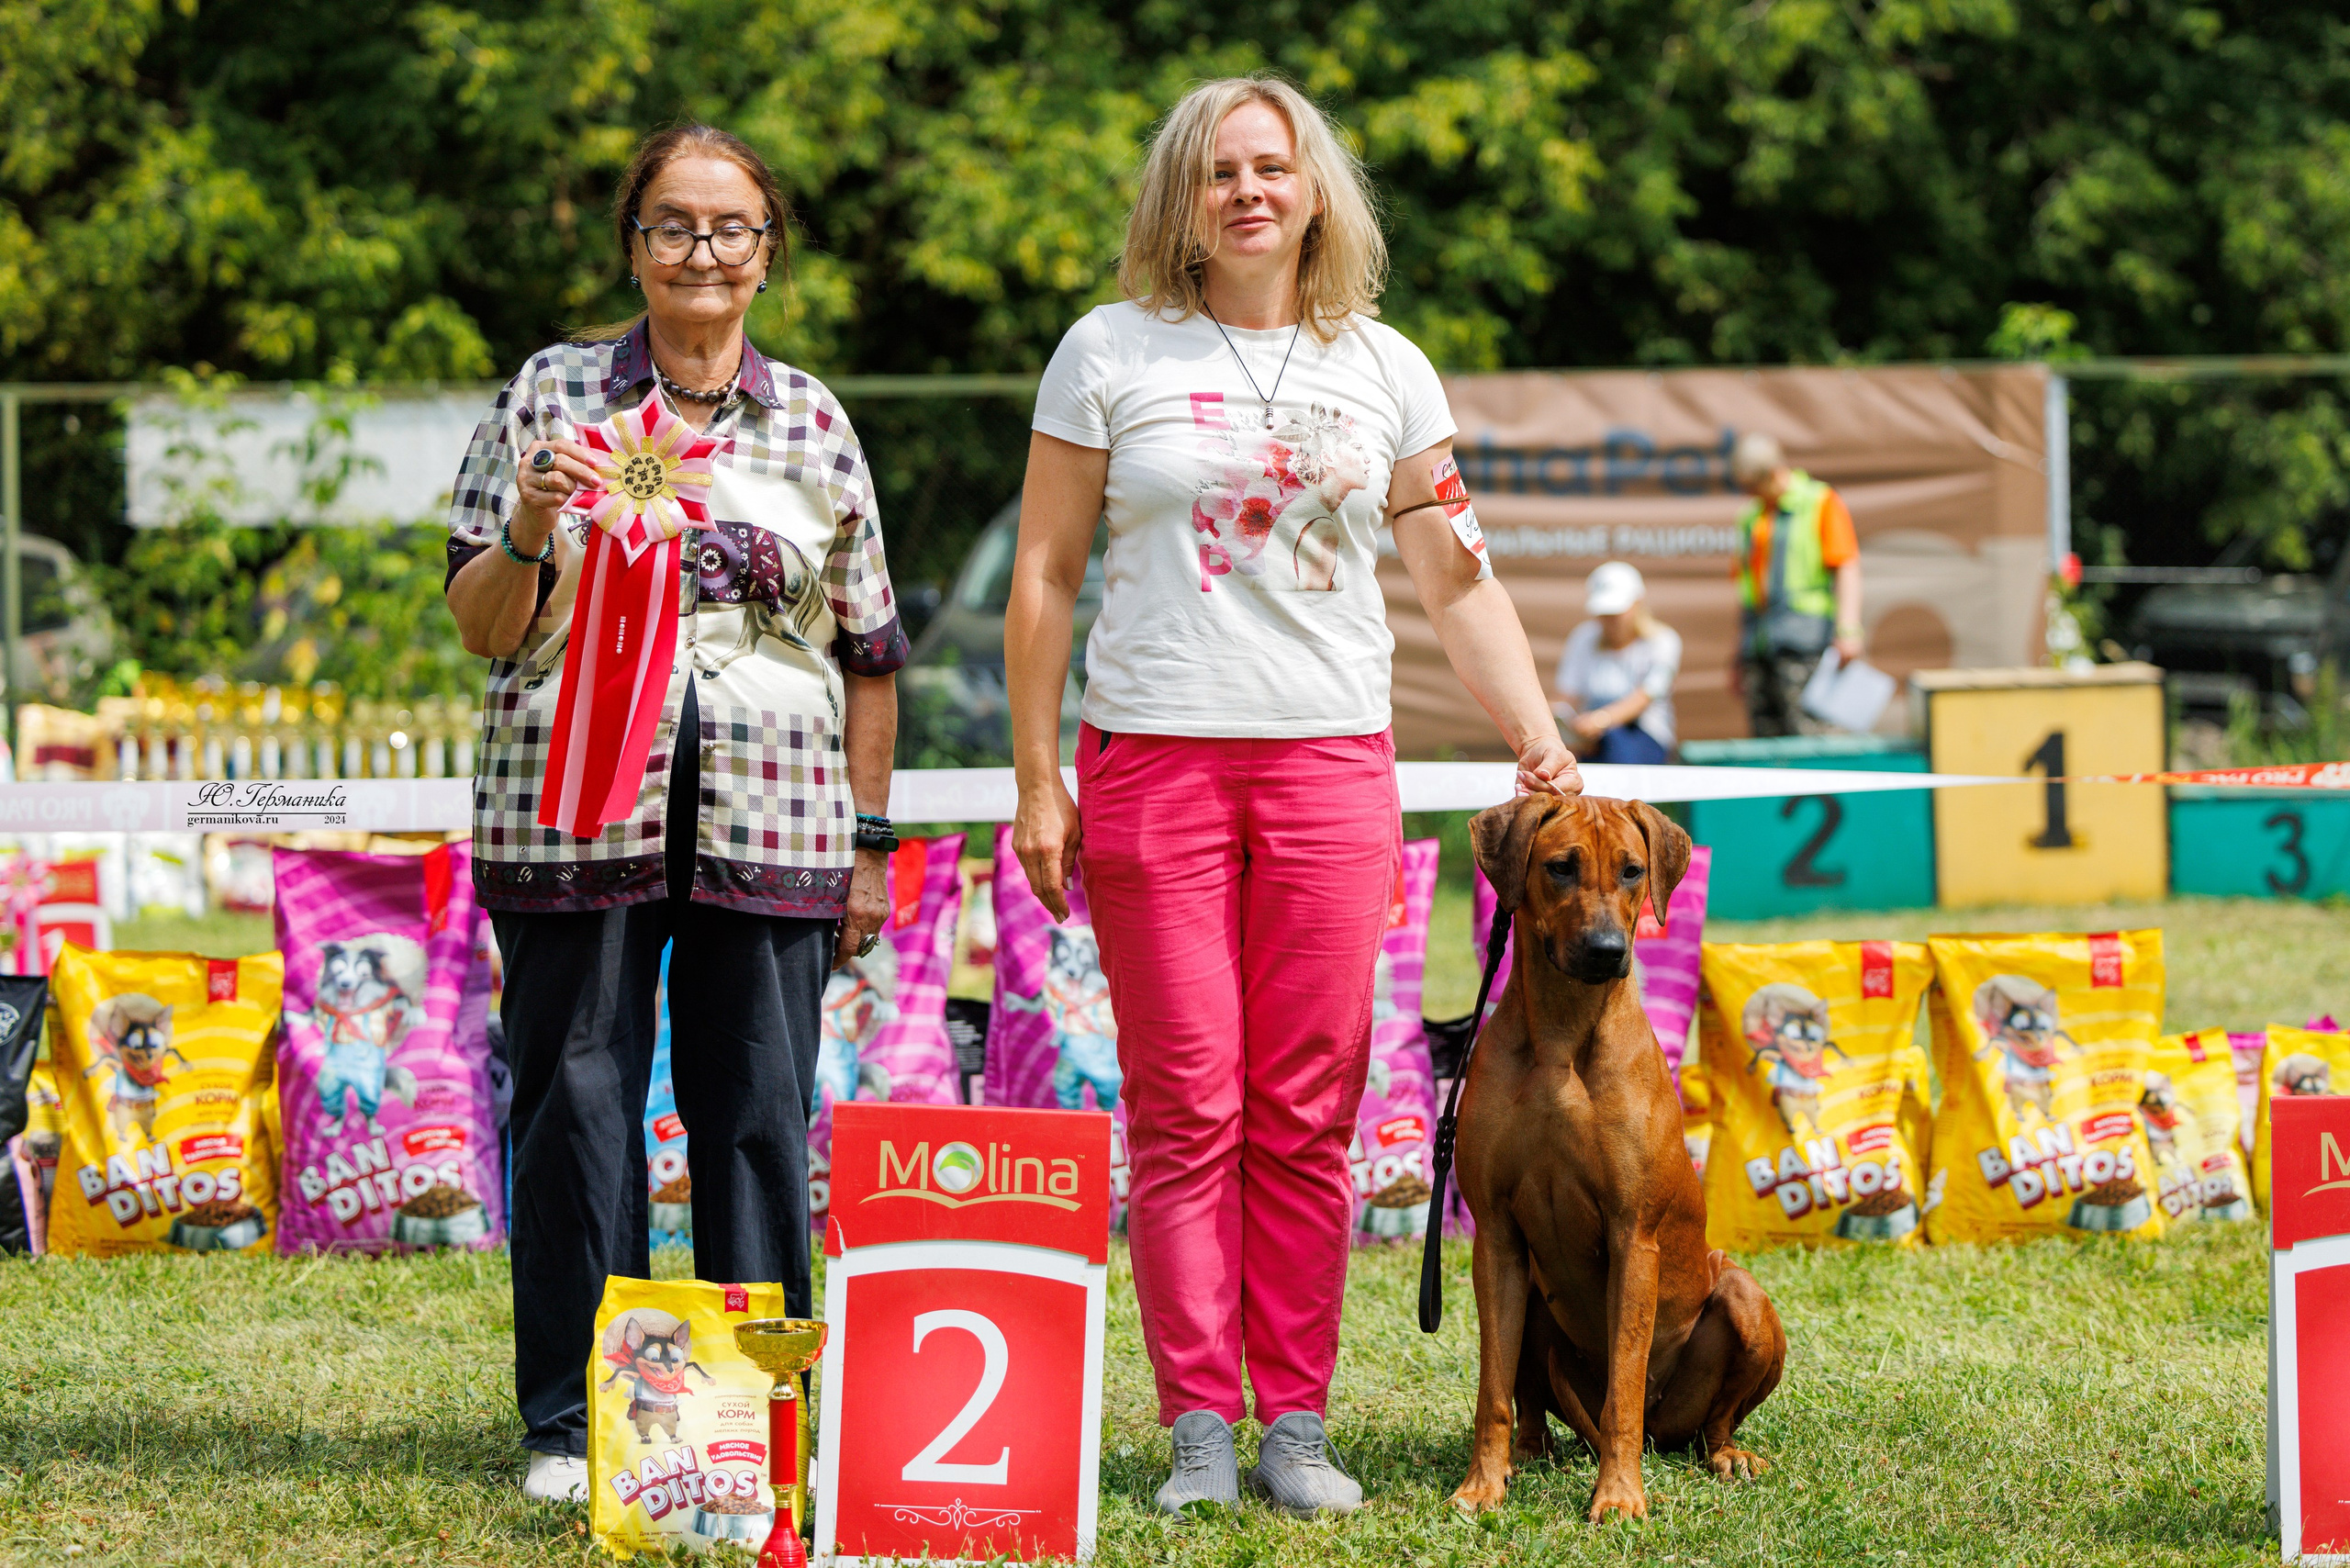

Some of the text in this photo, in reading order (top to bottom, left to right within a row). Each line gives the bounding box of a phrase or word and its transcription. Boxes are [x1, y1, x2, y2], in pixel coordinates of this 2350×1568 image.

[2023, 731, 2075, 849] 1
[1780, 792, 1845, 888] 2
[2262, 812, 2309, 895] 3
[77, 1143, 173, 1206] BAN
[299, 1137, 392, 1207] BAN
[1745, 1137, 1841, 1198] BAN
[1977, 1123, 2075, 1188] BAN
[2009, 1147, 2136, 1209] DITOS
[106, 1167, 242, 1228] DITOS
[327, 1159, 463, 1227] DITOS
[1774, 1157, 1902, 1220] DITOS
[717, 1409, 755, 1419] КОРМ
[901, 1309, 1010, 1484] 2
[610, 1445, 700, 1506] BAN
[711, 1450, 763, 1462] УДОВОЛЬСТВИЕ
[639, 1469, 759, 1522] DITOS
